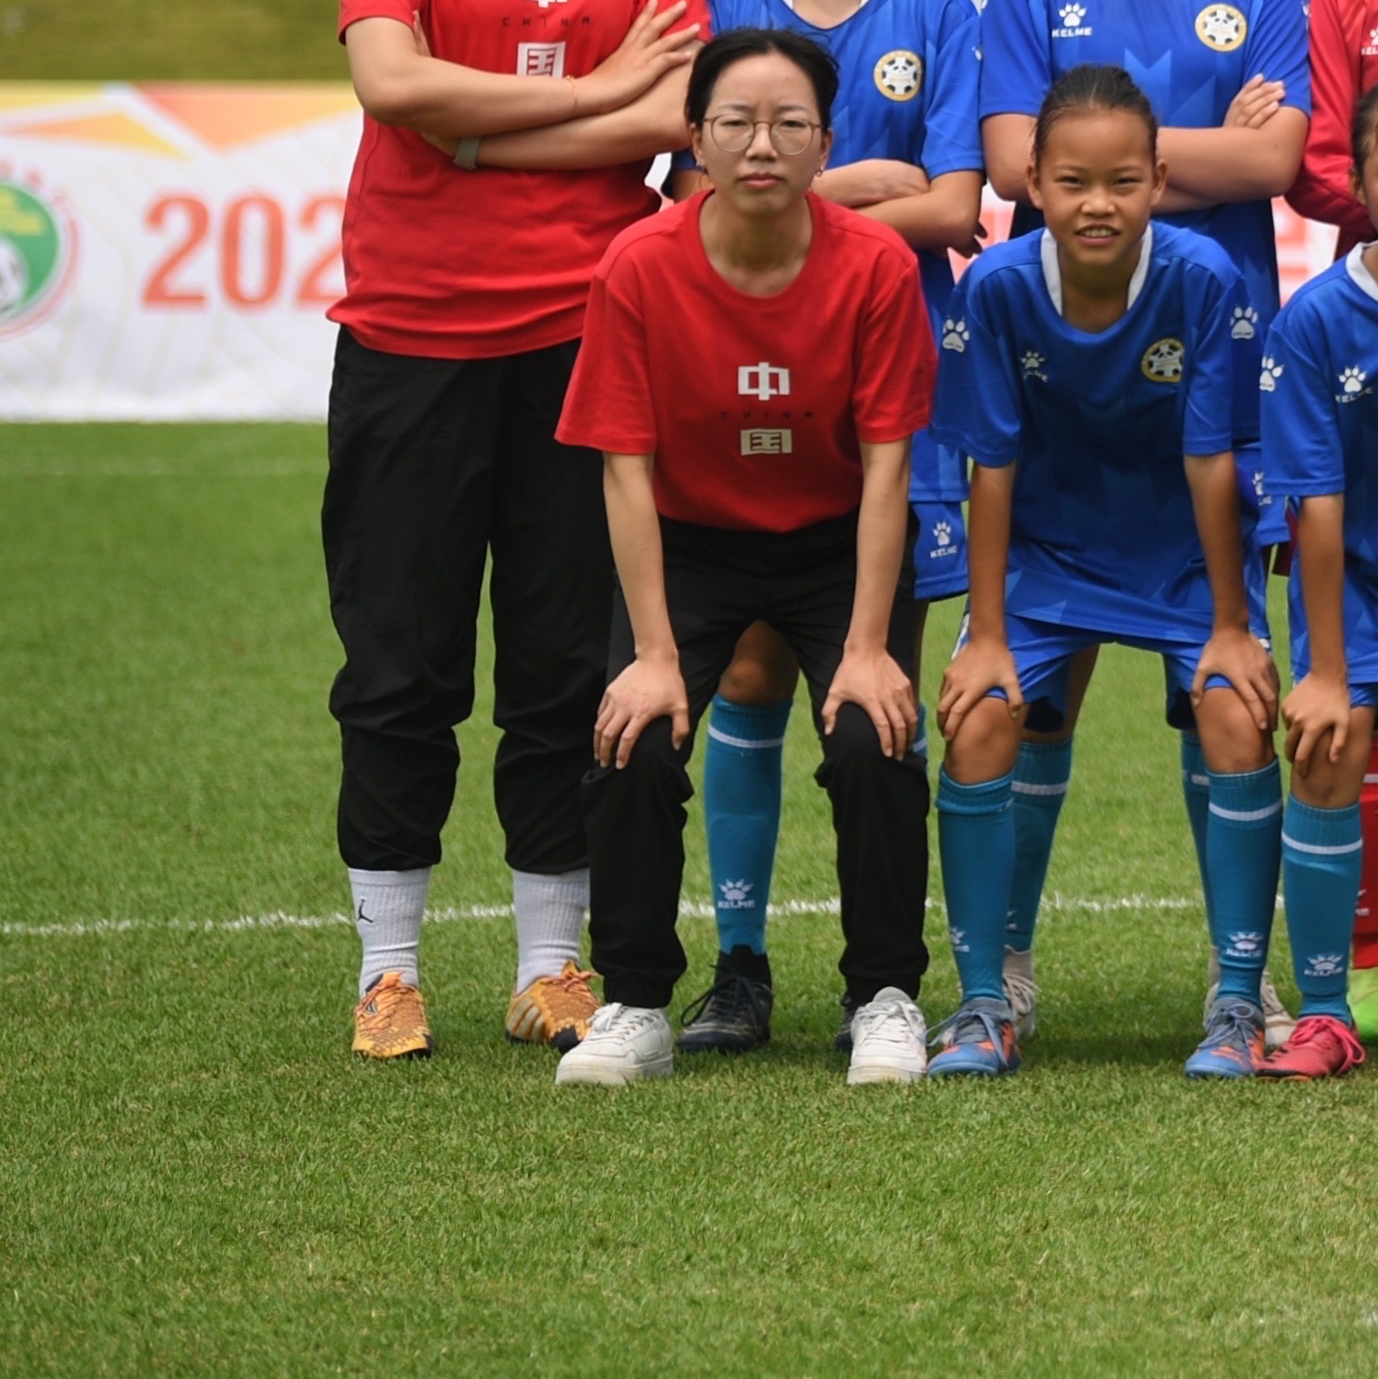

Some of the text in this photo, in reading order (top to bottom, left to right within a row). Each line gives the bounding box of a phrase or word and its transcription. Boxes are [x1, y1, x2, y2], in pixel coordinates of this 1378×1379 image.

[502, 16, 592, 28] CHINA
[1051, 27, 1092, 38] KELME
[930, 545, 957, 559] KELME
[717, 899, 755, 909] KELME
[1304, 967, 1343, 977] KELME
